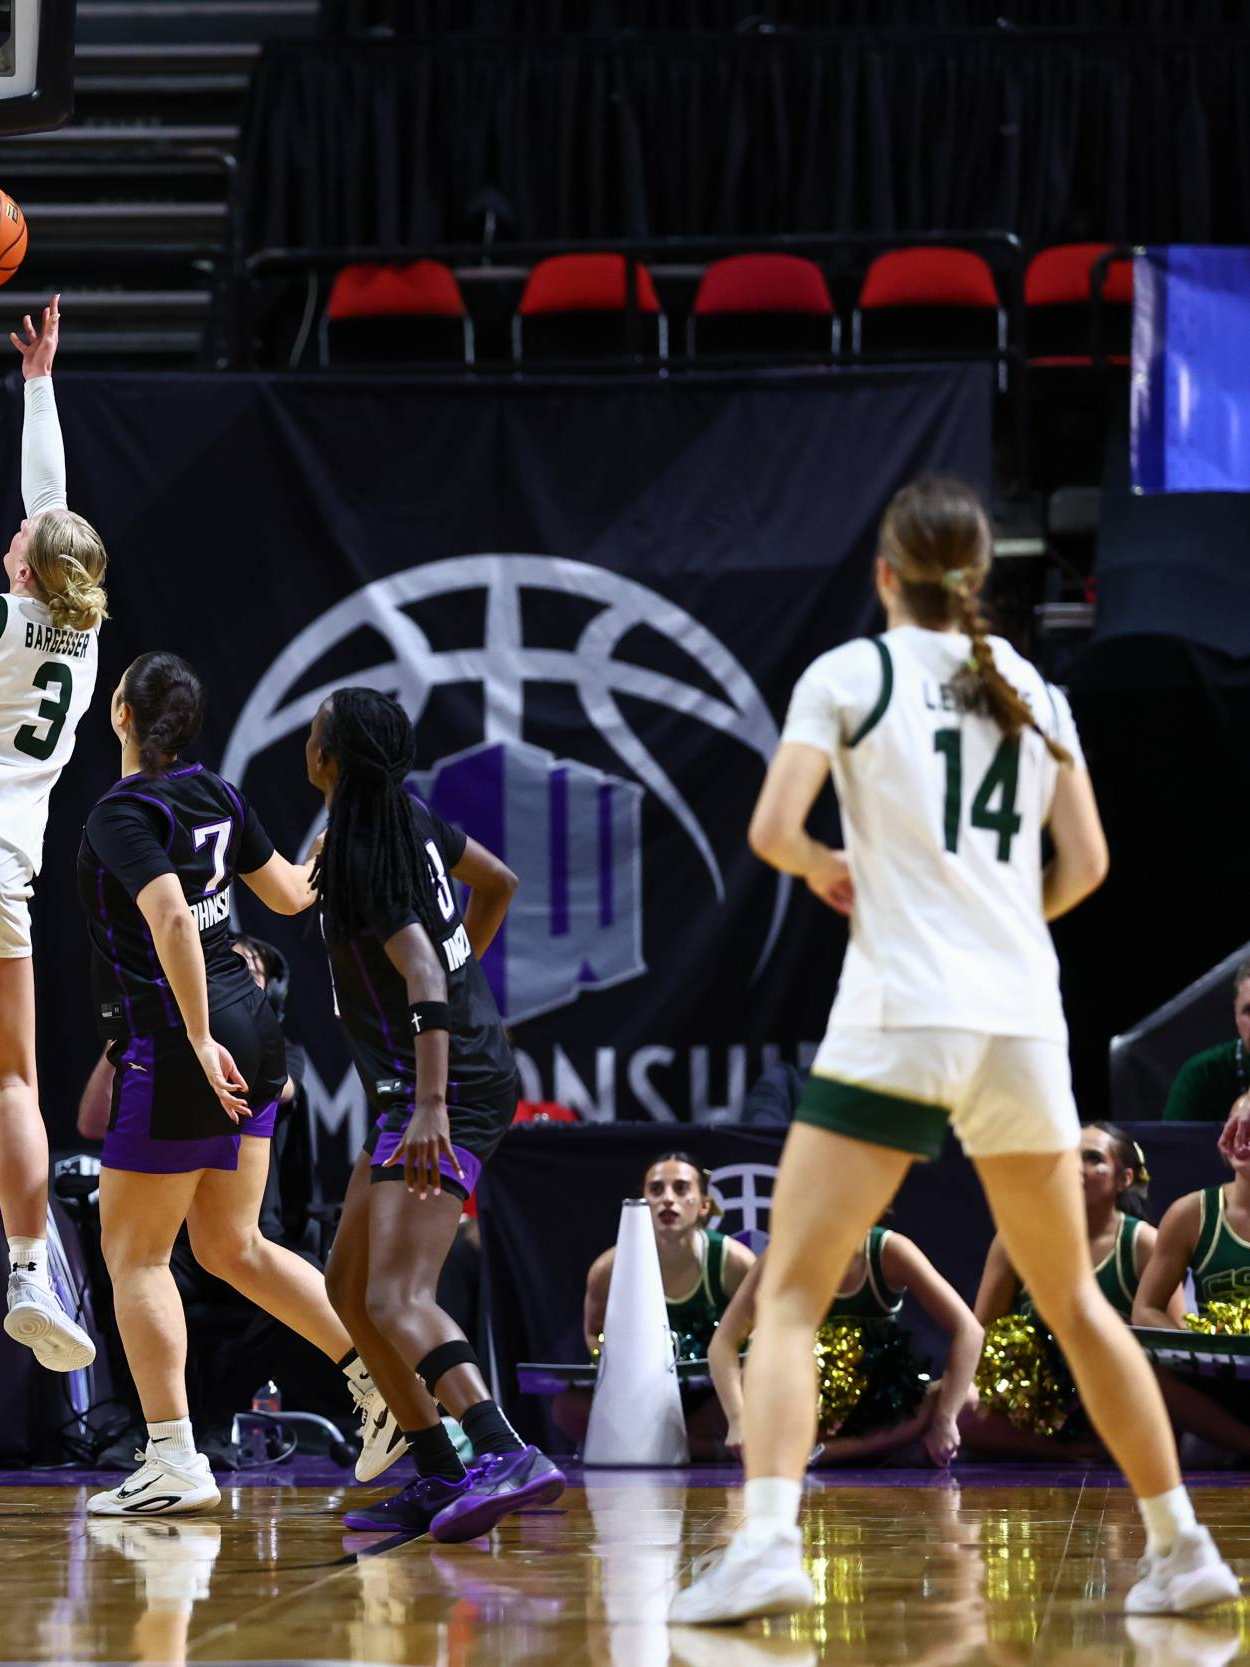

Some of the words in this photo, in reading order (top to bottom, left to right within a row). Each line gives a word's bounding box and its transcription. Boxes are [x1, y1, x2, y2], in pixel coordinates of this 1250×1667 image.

[25, 622, 90, 658] BARGESSER
[13, 661, 73, 761] 3
[934, 728, 1022, 863] 14
[192, 819, 233, 893] 7
